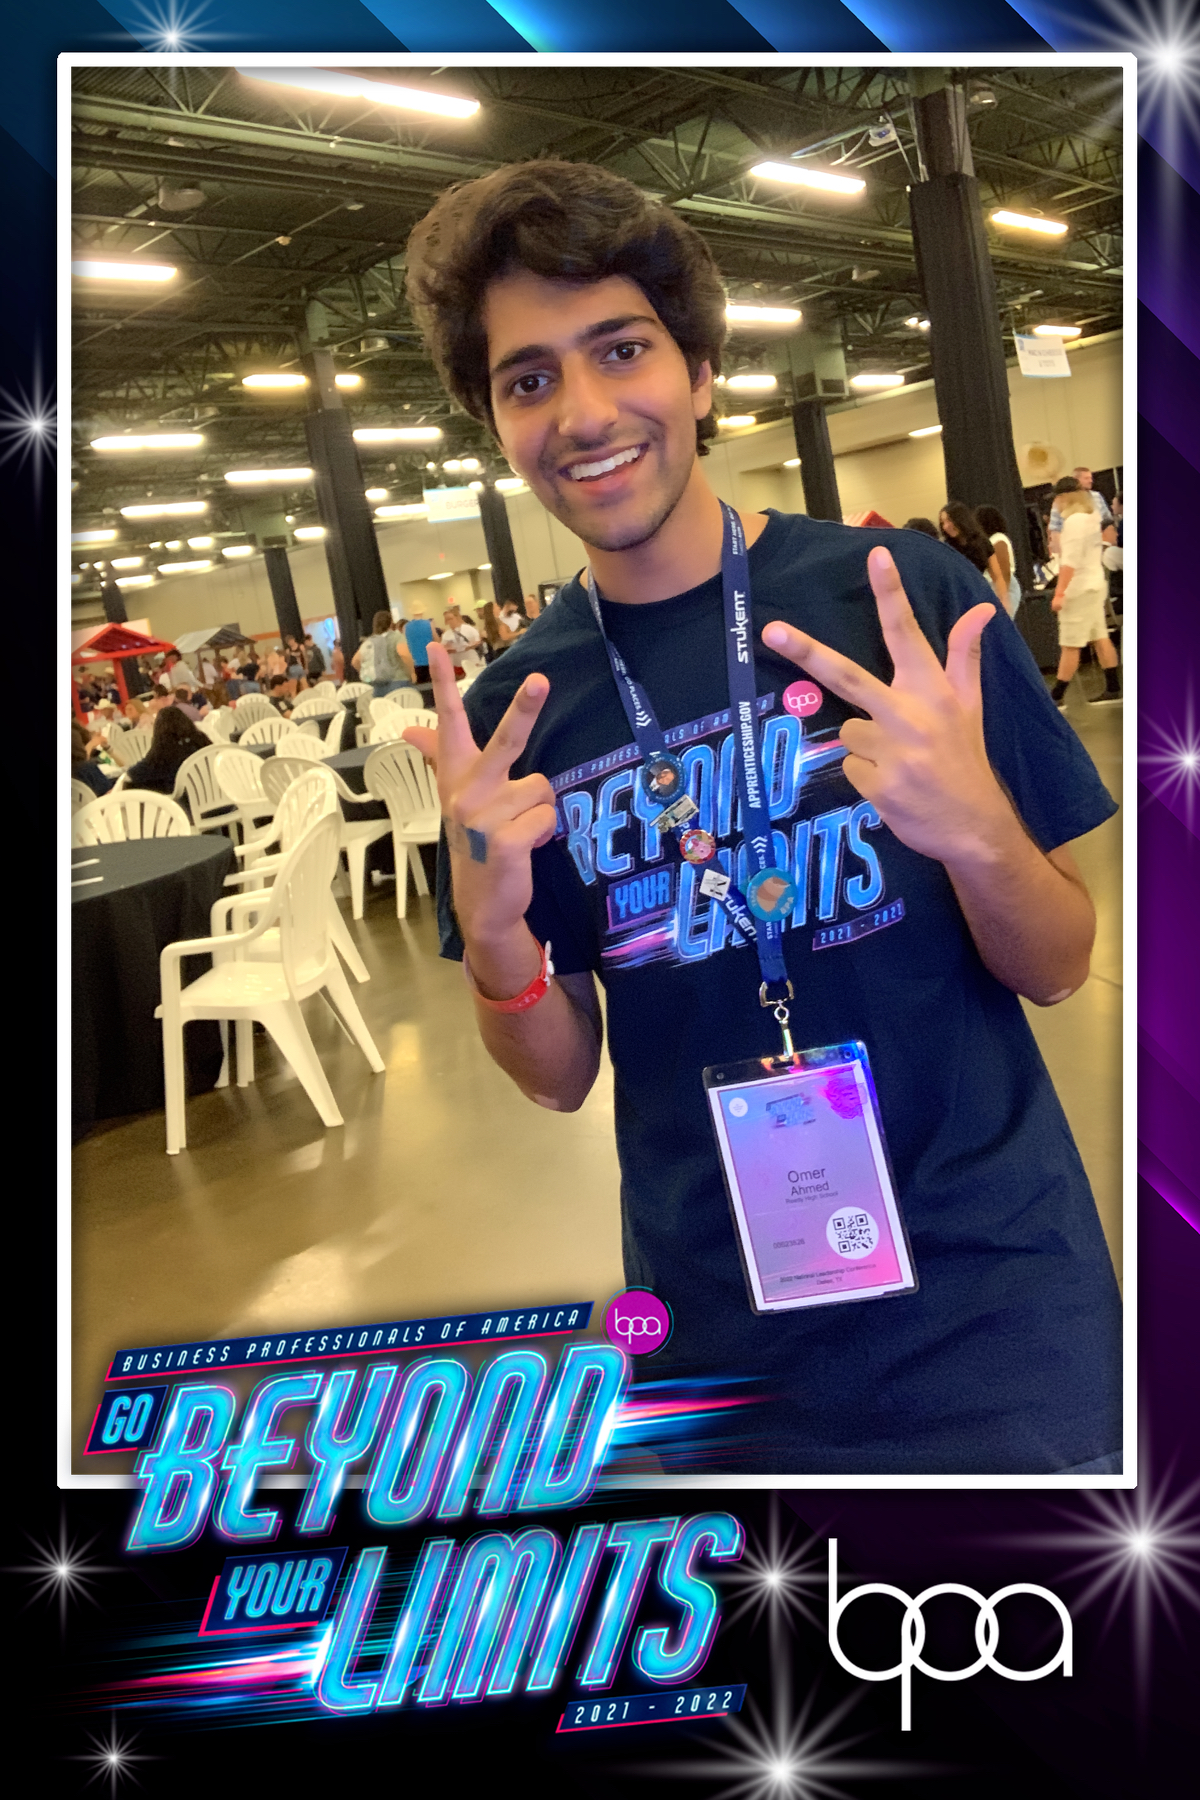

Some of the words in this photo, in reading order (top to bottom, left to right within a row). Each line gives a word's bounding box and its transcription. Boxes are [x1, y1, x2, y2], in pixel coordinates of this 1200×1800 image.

[738, 701, 762, 809] APPRENTICESHIP.GOV
[615, 869, 671, 919] YOUR
[820, 928, 850, 944] 2021
[787, 1167, 826, 1184] Omer
[791, 1181, 830, 1196] Ahmed
